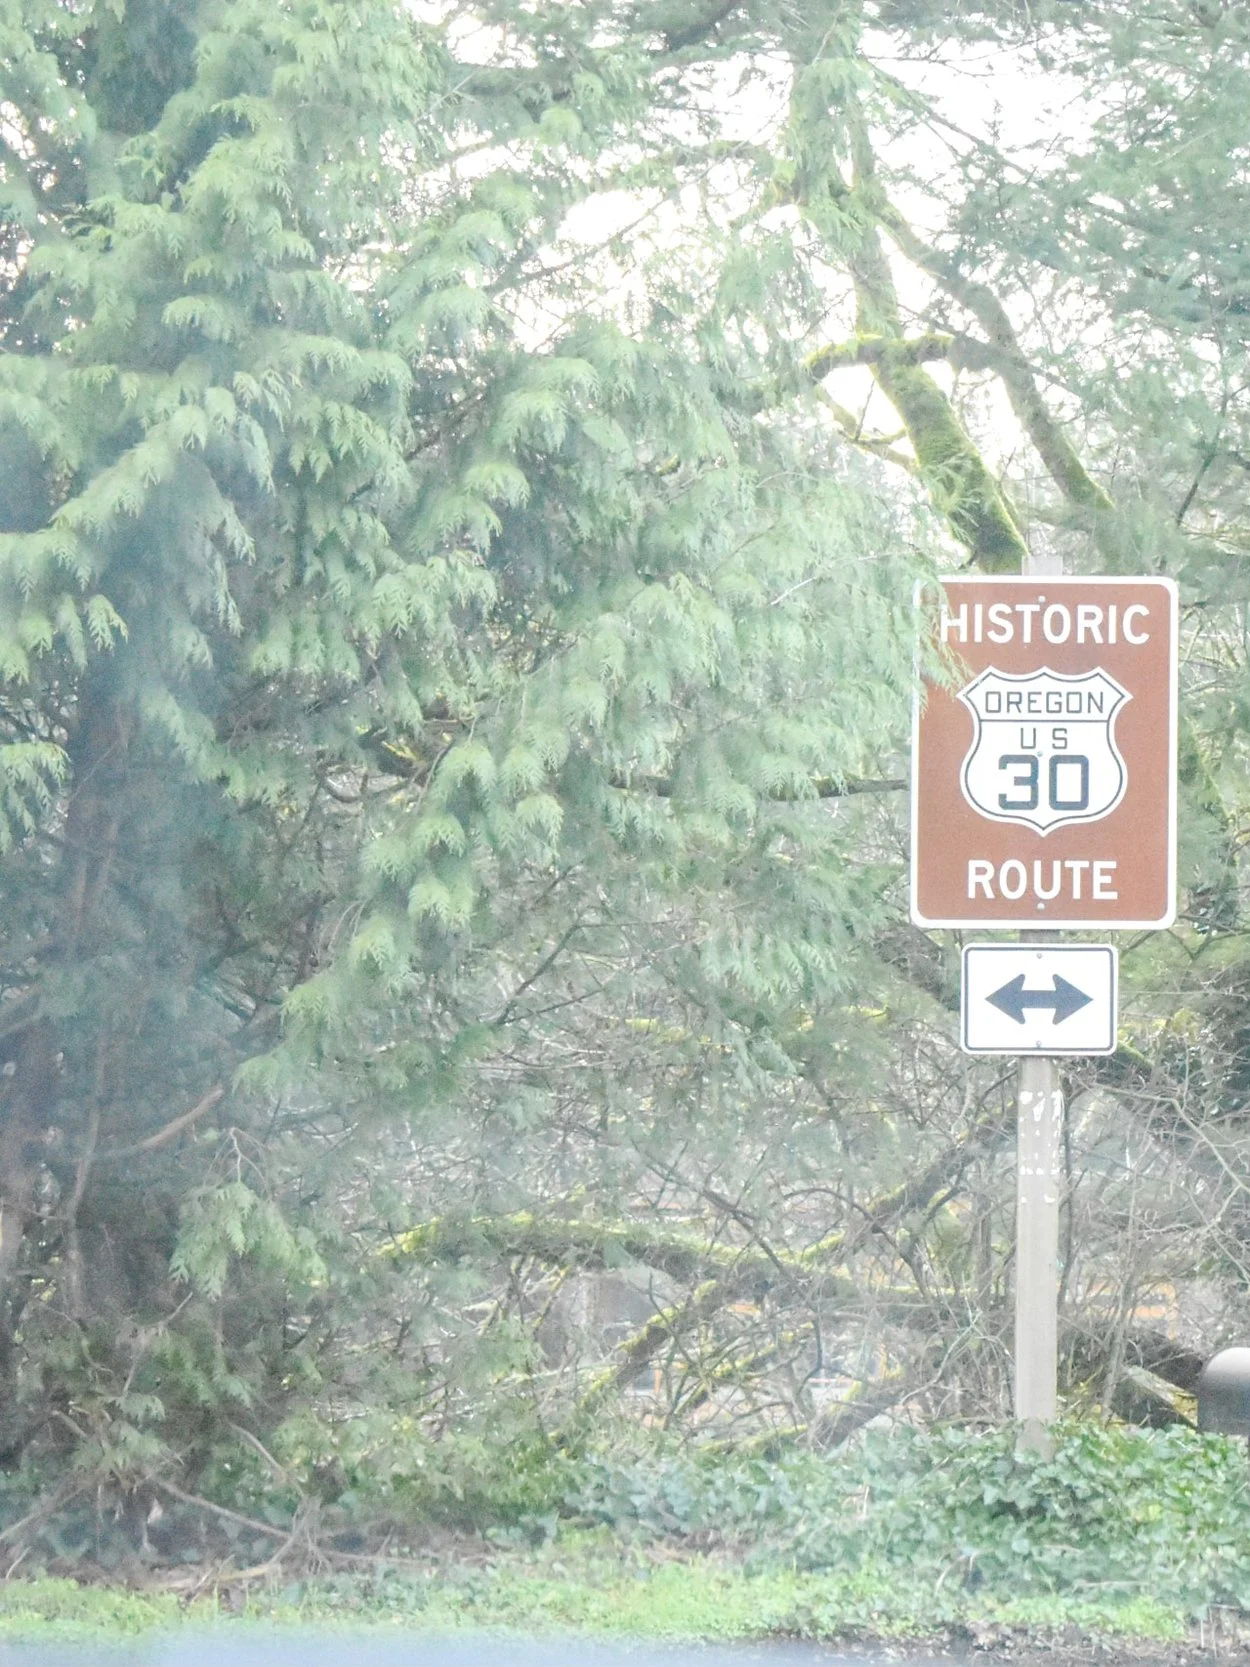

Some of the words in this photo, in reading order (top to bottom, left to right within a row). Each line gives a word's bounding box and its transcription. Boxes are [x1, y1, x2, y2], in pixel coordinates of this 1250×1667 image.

[940, 603, 1150, 645] HISTORIC
[985, 691, 1104, 714] OREGON
[998, 754, 1090, 811] 30
[967, 859, 1118, 900] ROUTE
